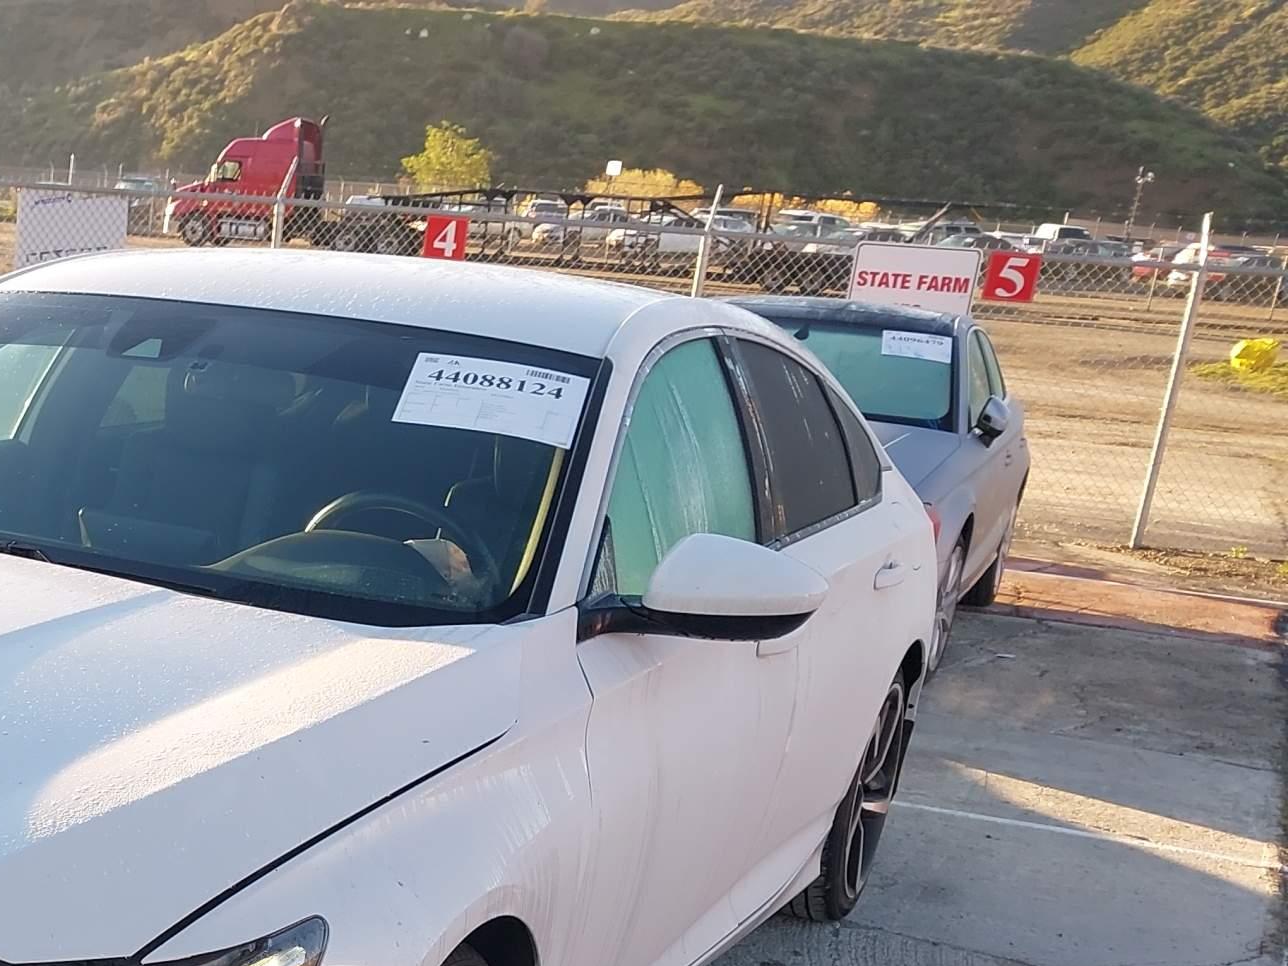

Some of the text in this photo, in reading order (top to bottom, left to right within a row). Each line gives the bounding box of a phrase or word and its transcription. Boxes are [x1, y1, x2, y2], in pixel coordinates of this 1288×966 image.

[432, 220, 457, 257] 4
[856, 270, 970, 294] STATE FARM
[994, 256, 1030, 298] 5
[427, 368, 564, 400] 44088124
